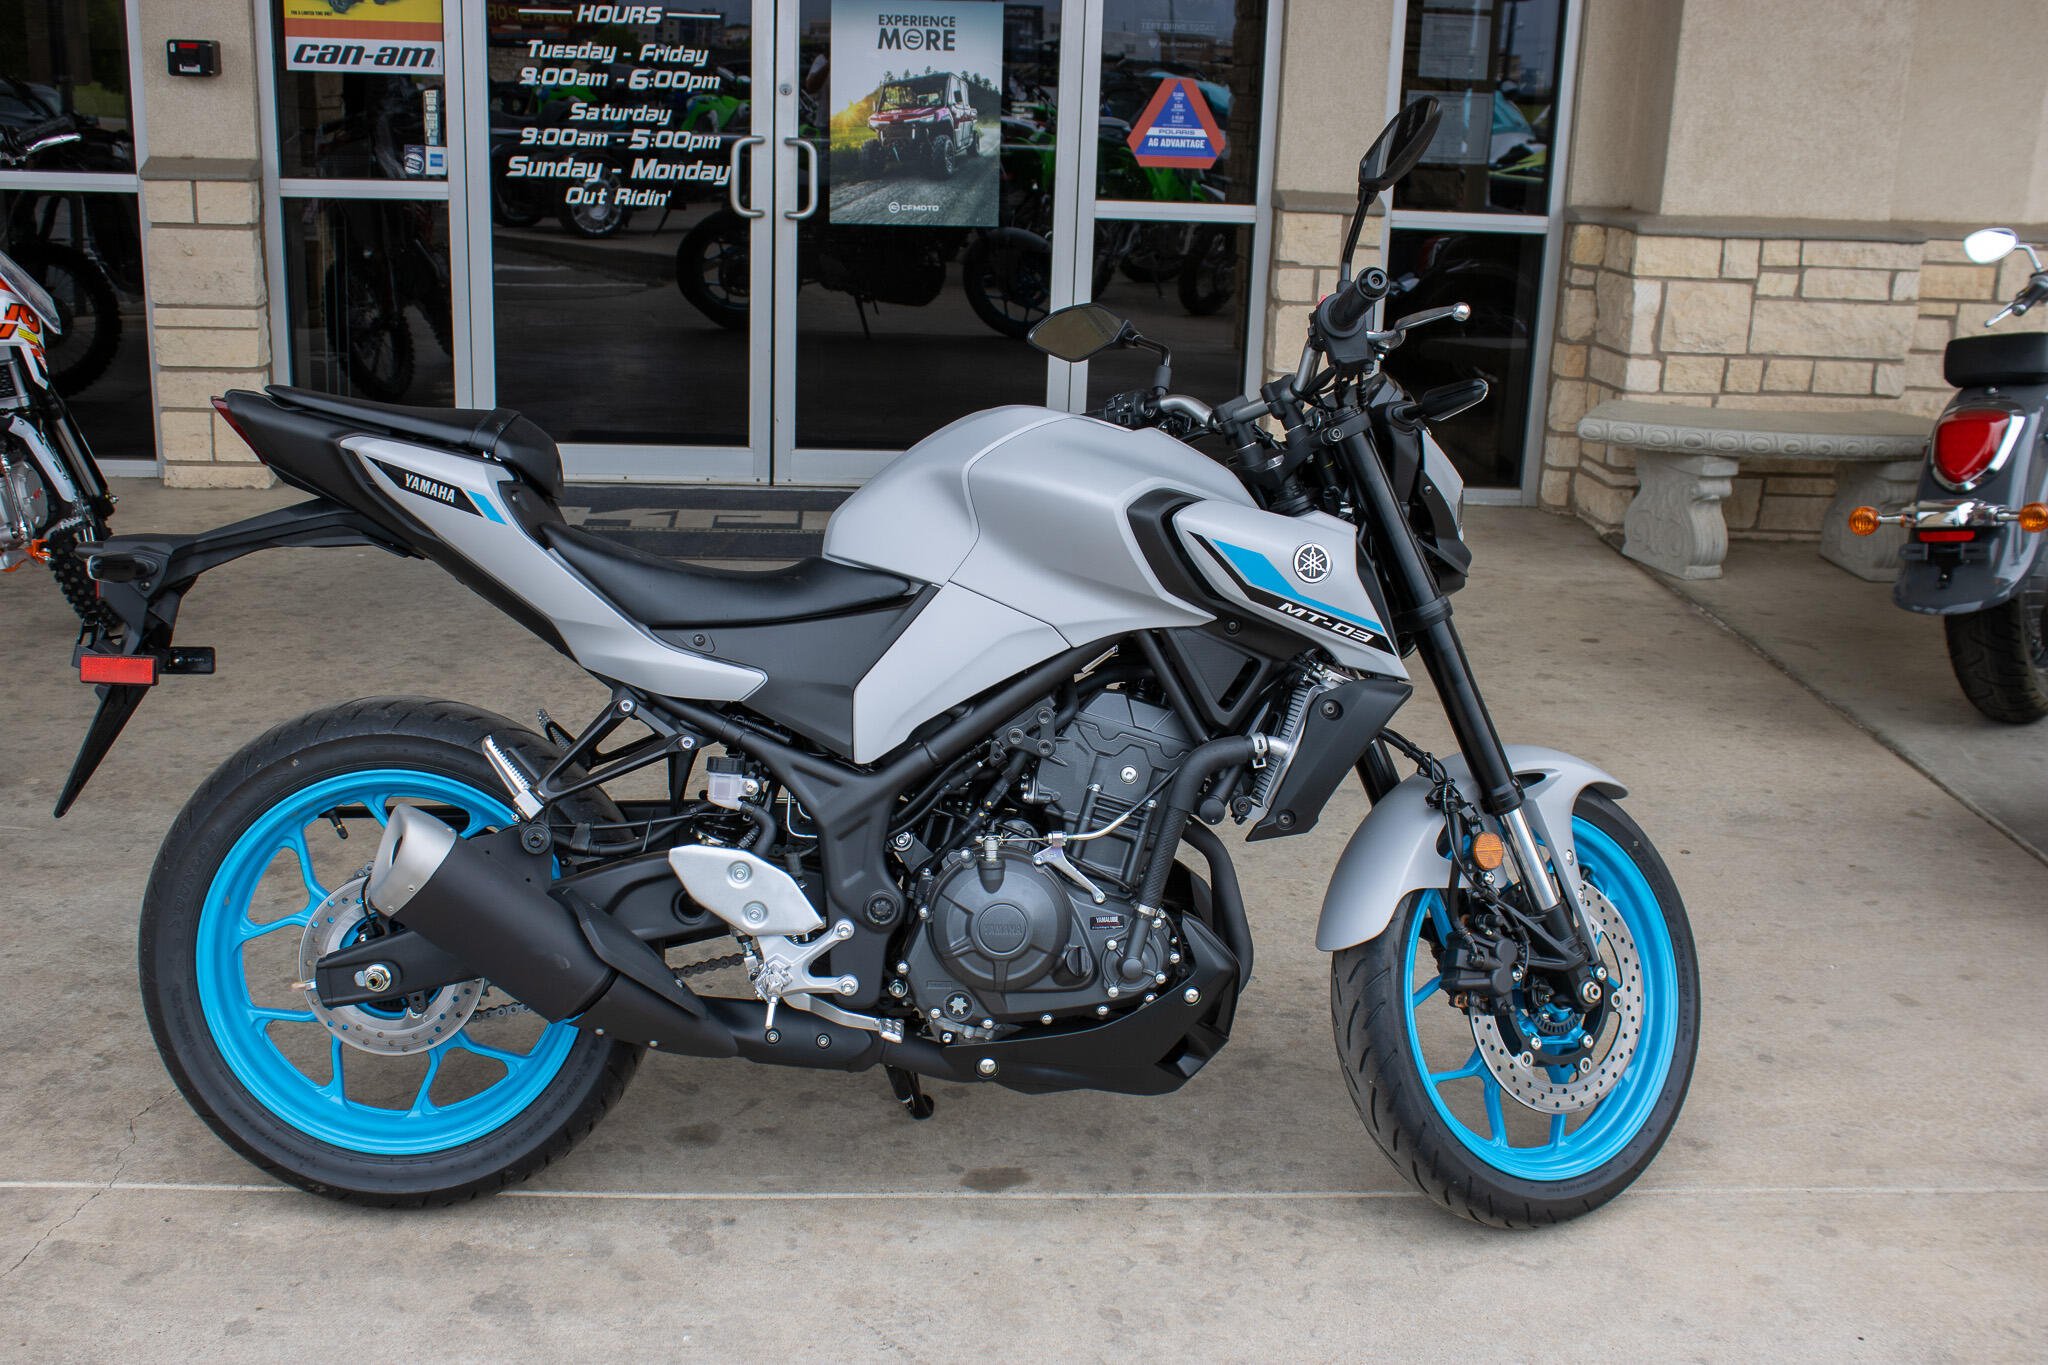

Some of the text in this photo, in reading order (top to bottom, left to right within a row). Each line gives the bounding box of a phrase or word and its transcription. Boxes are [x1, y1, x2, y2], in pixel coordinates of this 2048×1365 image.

[576, 4, 663, 25] HOURS
[878, 14, 956, 27] EXPERIENCE
[878, 28, 956, 51] MORE
[293, 43, 434, 67] can-am
[527, 40, 617, 64] Tuesday
[639, 44, 709, 67] Friday
[519, 66, 609, 87] 9:00am
[629, 68, 721, 92] 6:00pm
[569, 102, 672, 125] Saturday
[519, 127, 609, 148] 9:00am
[628, 129, 722, 153] 5:00pm
[1148, 138, 1206, 149] AG ADVANTAGE
[506, 156, 603, 183] Sunday
[630, 158, 732, 186] Monday
[565, 186, 672, 207] Out Ridin'
[901, 204, 940, 212] CFMOTO
[405, 473, 455, 503] YAMAHA
[1278, 602, 1375, 643] MT-03
